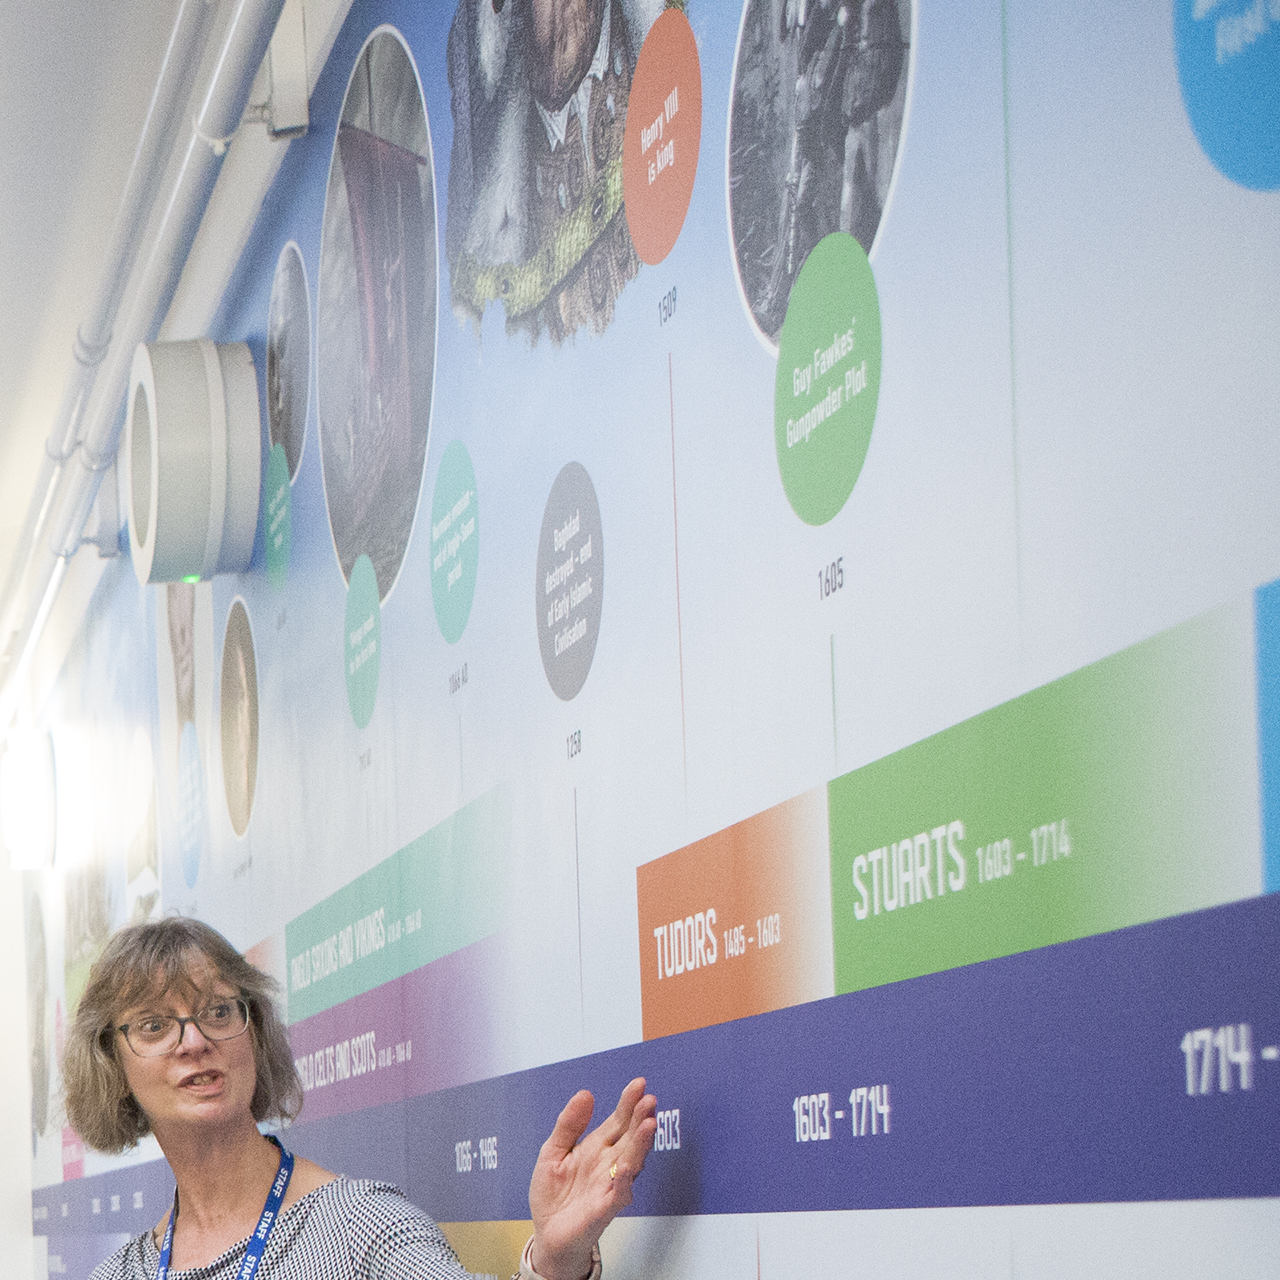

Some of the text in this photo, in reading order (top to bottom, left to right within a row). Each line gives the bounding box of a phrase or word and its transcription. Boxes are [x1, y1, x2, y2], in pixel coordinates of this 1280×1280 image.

[641, 87, 678, 155] Henry VIII
[648, 139, 674, 185] is king
[658, 285, 677, 327] 1509
[786, 360, 867, 448] Gunpowder Plot
[793, 364, 811, 397] Guy
[554, 509, 580, 552] Baghdad
[546, 550, 574, 594] destroyed
[580, 534, 591, 564] end
[818, 556, 843, 600] 1605
[548, 573, 592, 627] of Early Islamic
[566, 729, 581, 760] 1258
[852, 819, 966, 920] STUARTS
[975, 838, 1013, 883] 1603
[1030, 819, 1072, 867] 1714
[354, 906, 385, 960] VIKINGS
[653, 907, 717, 980] TUDORS
[723, 924, 745, 959] 1485
[756, 912, 780, 949] 1603
[314, 1045, 335, 1088] CELTS
[335, 1039, 350, 1082] AND
[351, 1030, 377, 1077] SCOTS
[1180, 1023, 1254, 1096] 1714
[793, 1092, 830, 1142] 1603
[849, 1084, 890, 1137] 1714
[455, 1140, 472, 1173] 1066
[479, 1136, 498, 1171] 1485
[271, 1168, 288, 1198] STAFF
[256, 1210, 274, 1240] STAFF
